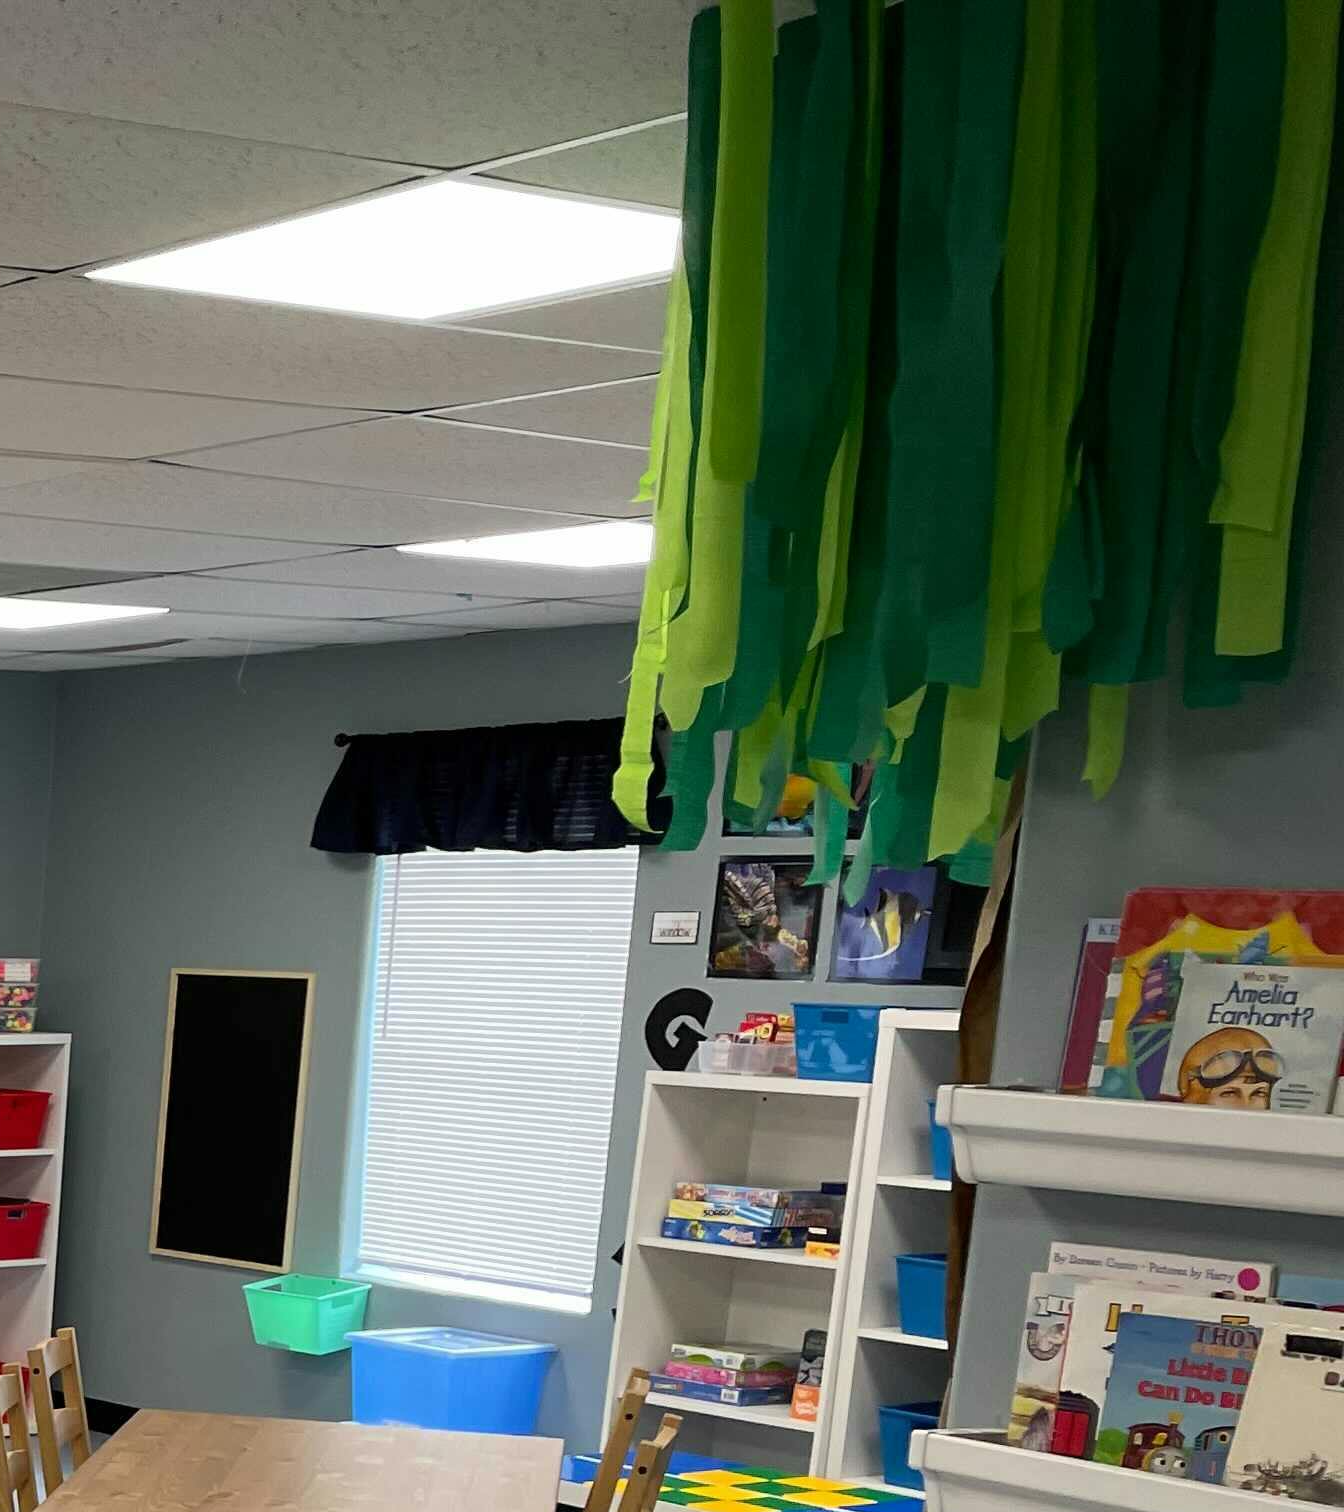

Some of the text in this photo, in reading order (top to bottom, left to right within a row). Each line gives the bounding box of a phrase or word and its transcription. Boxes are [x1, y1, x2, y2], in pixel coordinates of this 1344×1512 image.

[1225, 981, 1298, 1005] Amelia
[1208, 1003, 1314, 1028] Earhart?
[645, 988, 714, 1071] G
[1190, 1267, 1202, 1280] by
[1167, 1357, 1227, 1383] Little
[1138, 1380, 1180, 1401] Can
[1184, 1386, 1215, 1405] Do
